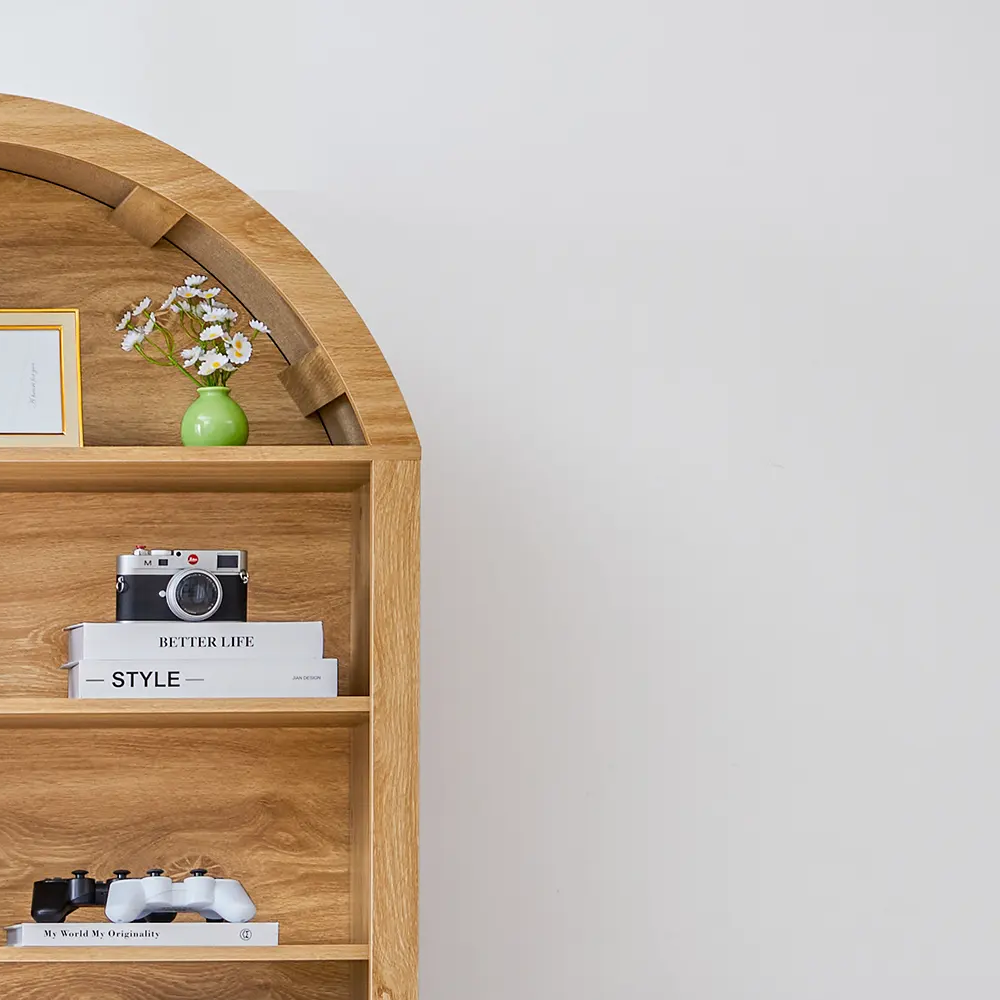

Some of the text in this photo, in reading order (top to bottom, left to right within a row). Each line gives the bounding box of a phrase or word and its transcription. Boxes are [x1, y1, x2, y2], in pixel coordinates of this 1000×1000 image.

[159, 636, 255, 648] BETTER LIFE
[112, 670, 181, 688] STYLE
[43, 929, 160, 939] My World My Originality
